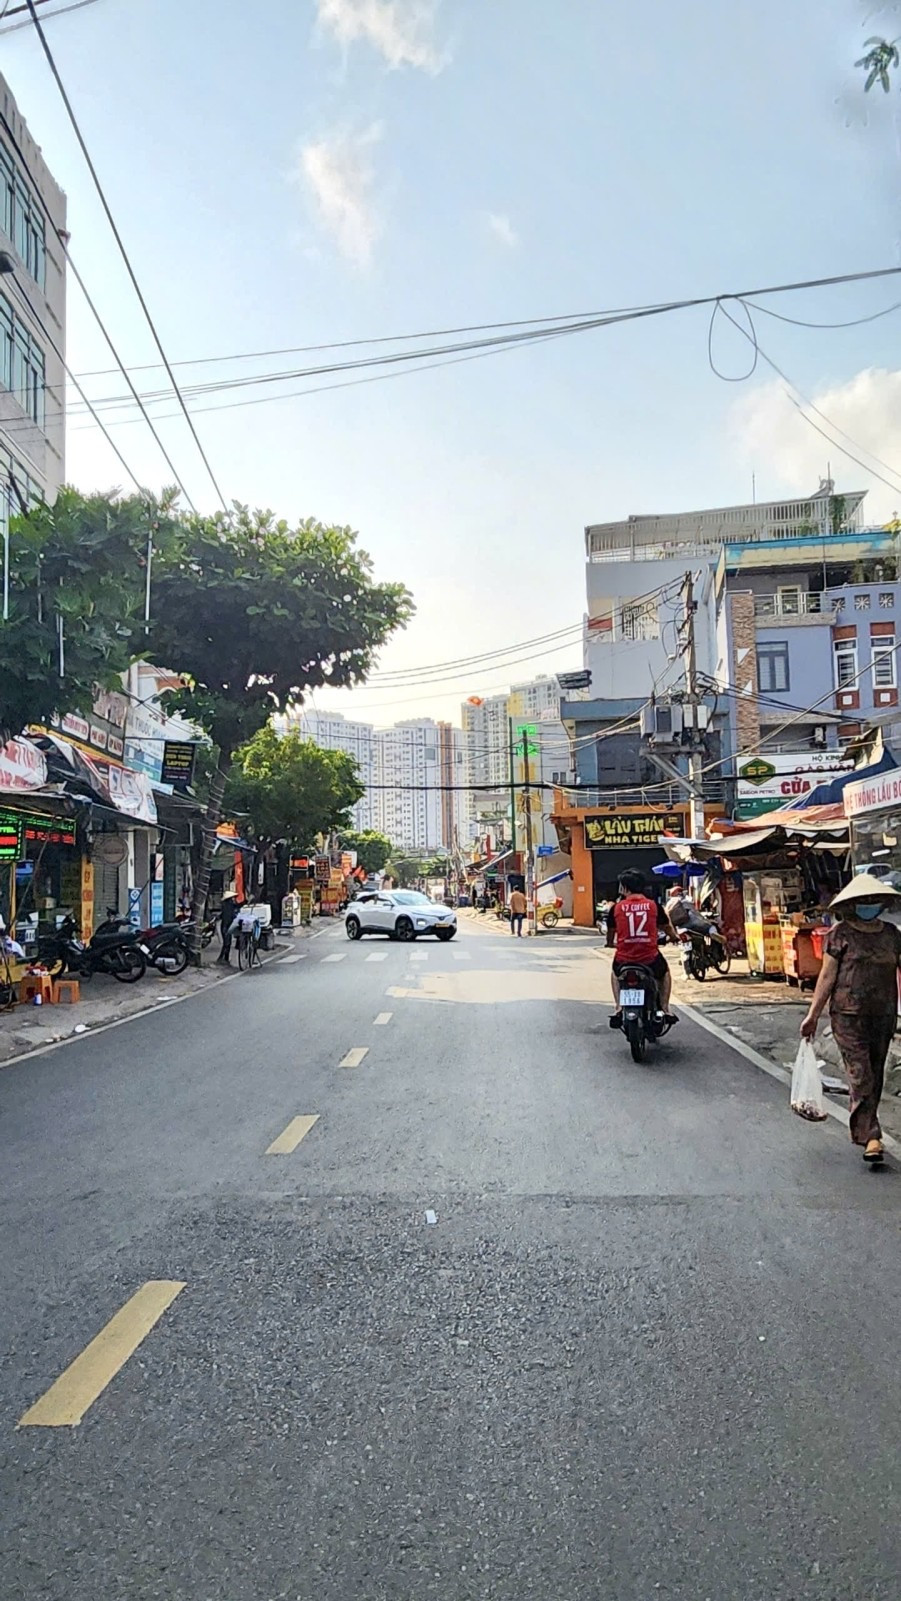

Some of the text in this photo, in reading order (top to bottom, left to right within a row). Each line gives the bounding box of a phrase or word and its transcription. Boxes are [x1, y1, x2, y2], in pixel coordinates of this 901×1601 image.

[780, 776, 811, 794] CỬA
[854, 784, 876, 809] THỐNG
[632, 815, 664, 832] THÁI
[631, 902, 650, 911] COFFEE
[625, 911, 648, 937] 12
